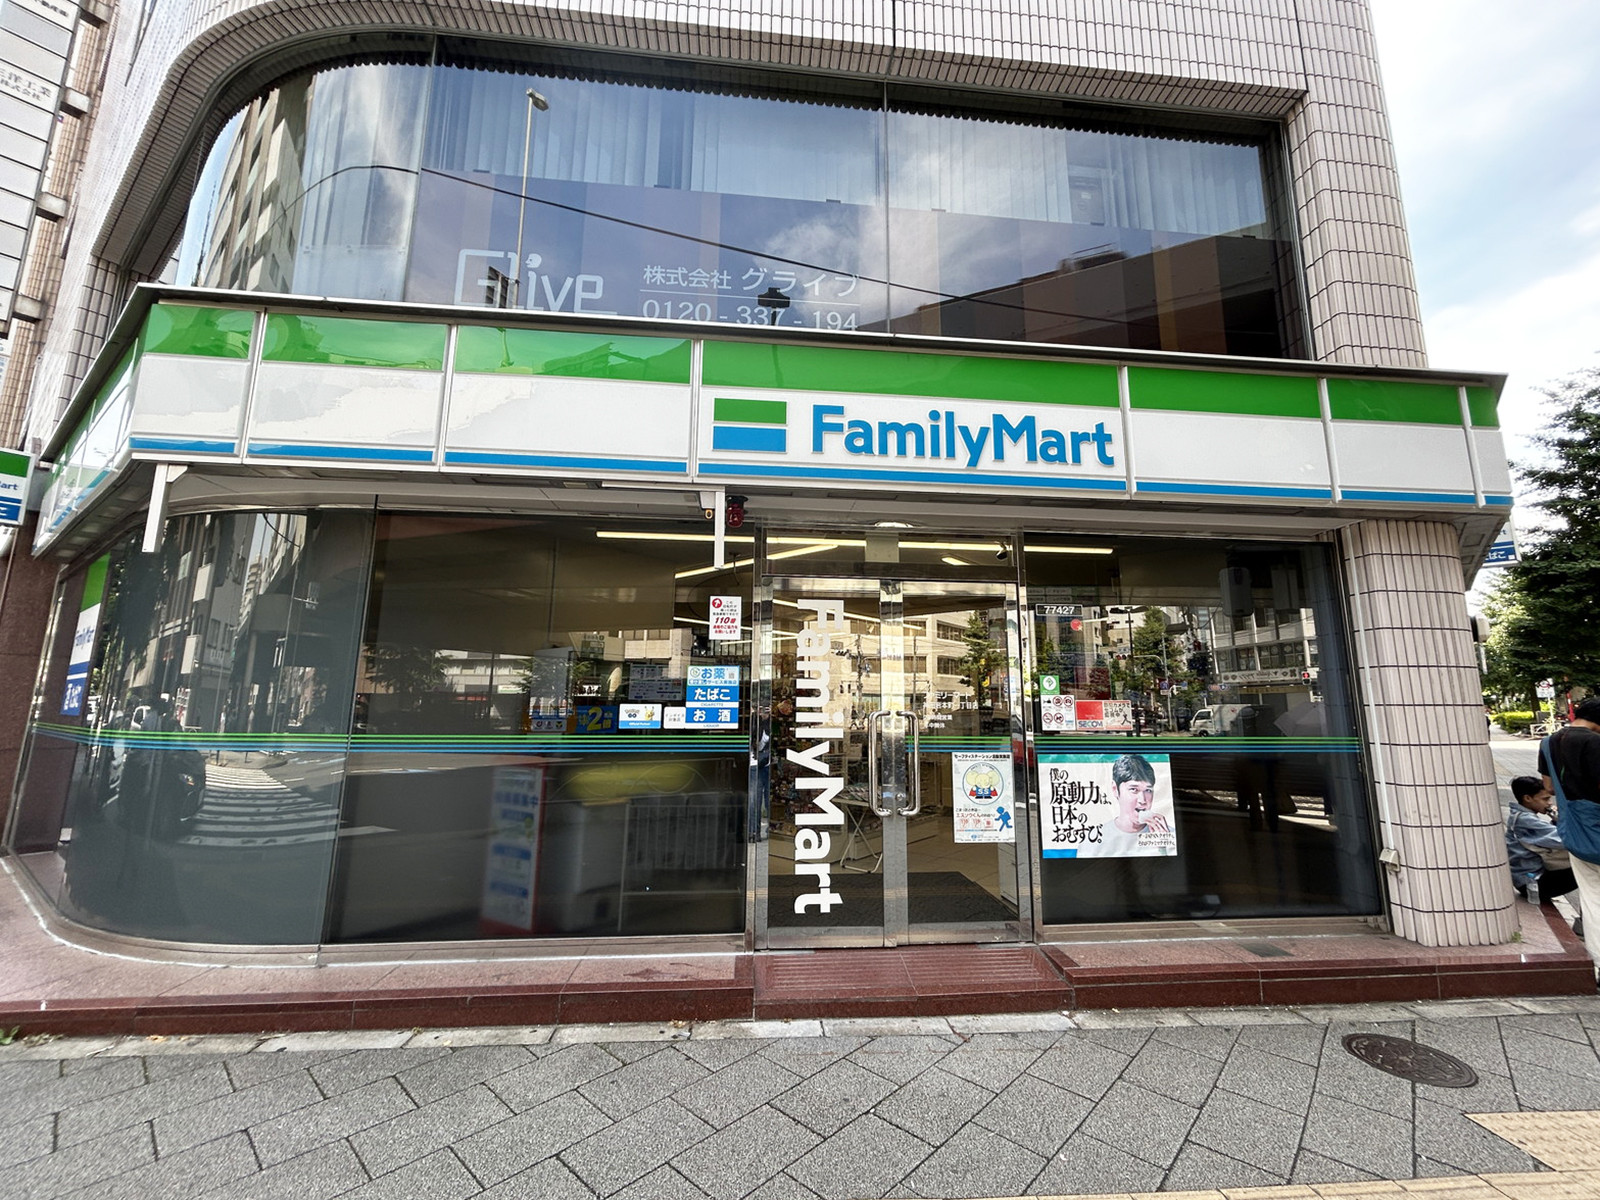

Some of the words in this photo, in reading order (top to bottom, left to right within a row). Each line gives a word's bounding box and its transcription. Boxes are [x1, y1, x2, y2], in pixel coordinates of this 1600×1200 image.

[643, 265, 732, 290] 株式会社
[812, 404, 1115, 467] FamilyMart
[1485, 551, 1507, 560] ばこ
[1043, 605, 1075, 615] 77427
[701, 667, 725, 680] お薬
[694, 687, 731, 701] たばこ
[1078, 720, 1103, 728] SECOM
[786, 599, 844, 914] FamilyMart
[1050, 767, 1069, 781] 僕の
[1050, 781, 1112, 805] 原動力は、
[1051, 805, 1088, 825] 日本の
[1051, 824, 1103, 844] おむすび。
